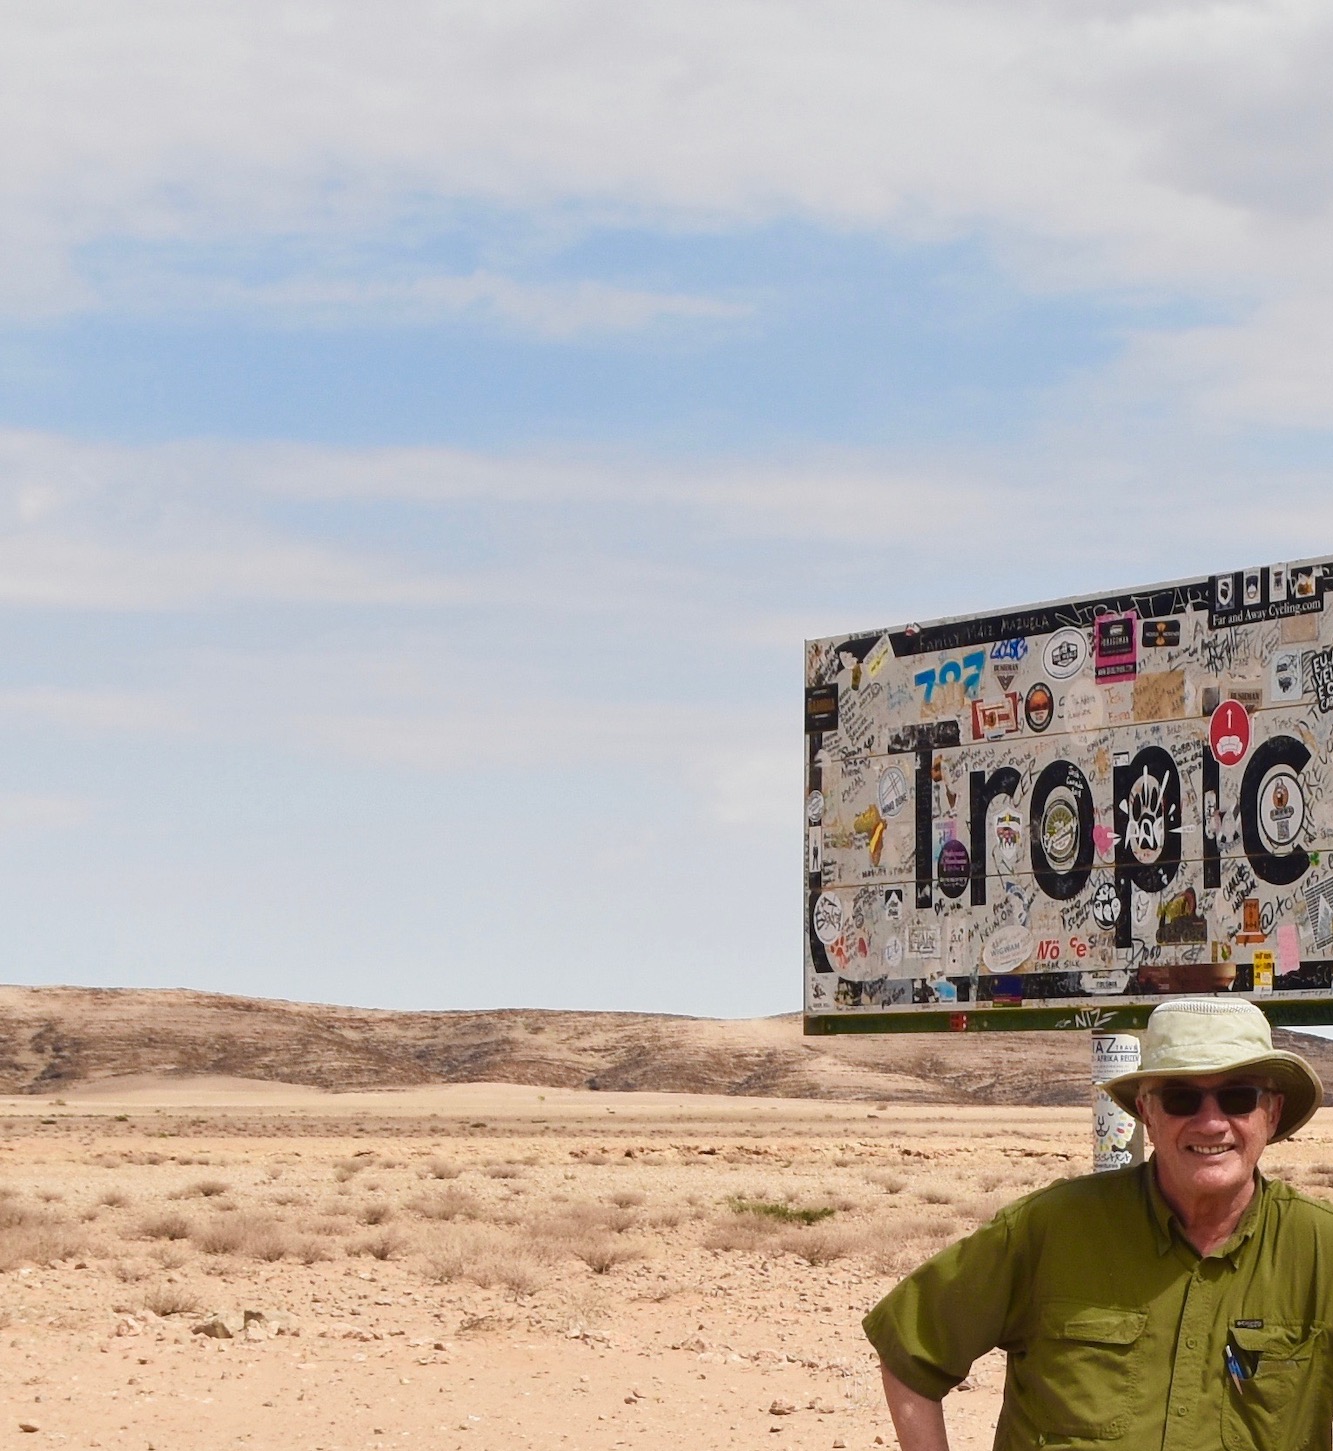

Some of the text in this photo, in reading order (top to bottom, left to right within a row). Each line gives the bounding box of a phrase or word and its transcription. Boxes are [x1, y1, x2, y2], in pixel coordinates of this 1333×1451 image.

[1213, 599, 1321, 626] Far and Away Cycling.com
